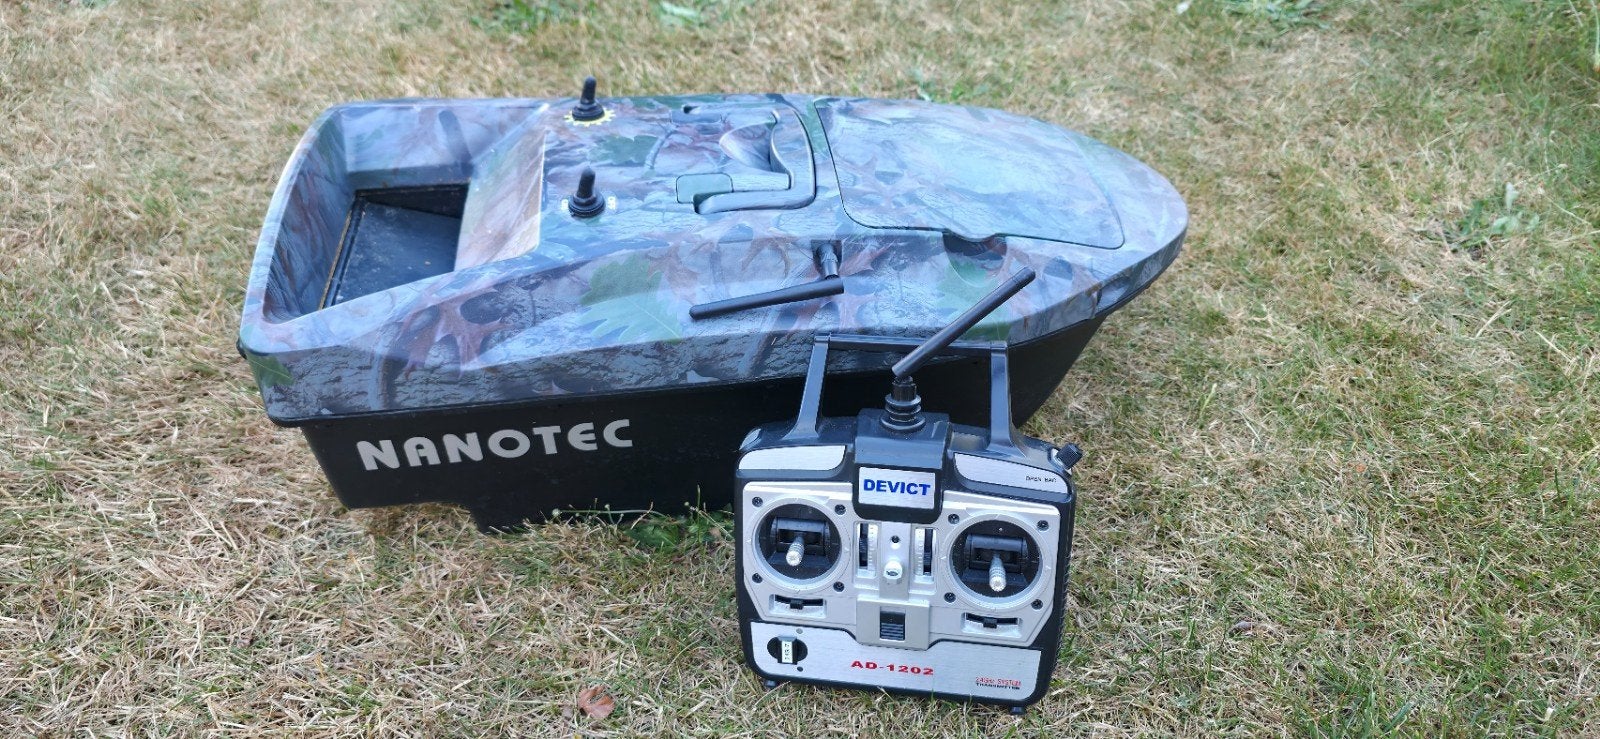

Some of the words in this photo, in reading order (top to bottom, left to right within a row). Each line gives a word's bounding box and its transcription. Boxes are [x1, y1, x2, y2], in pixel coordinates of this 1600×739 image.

[356, 418, 633, 471] NANOTEC
[863, 478, 931, 496] DEVICT
[851, 660, 934, 676] AD-1202
